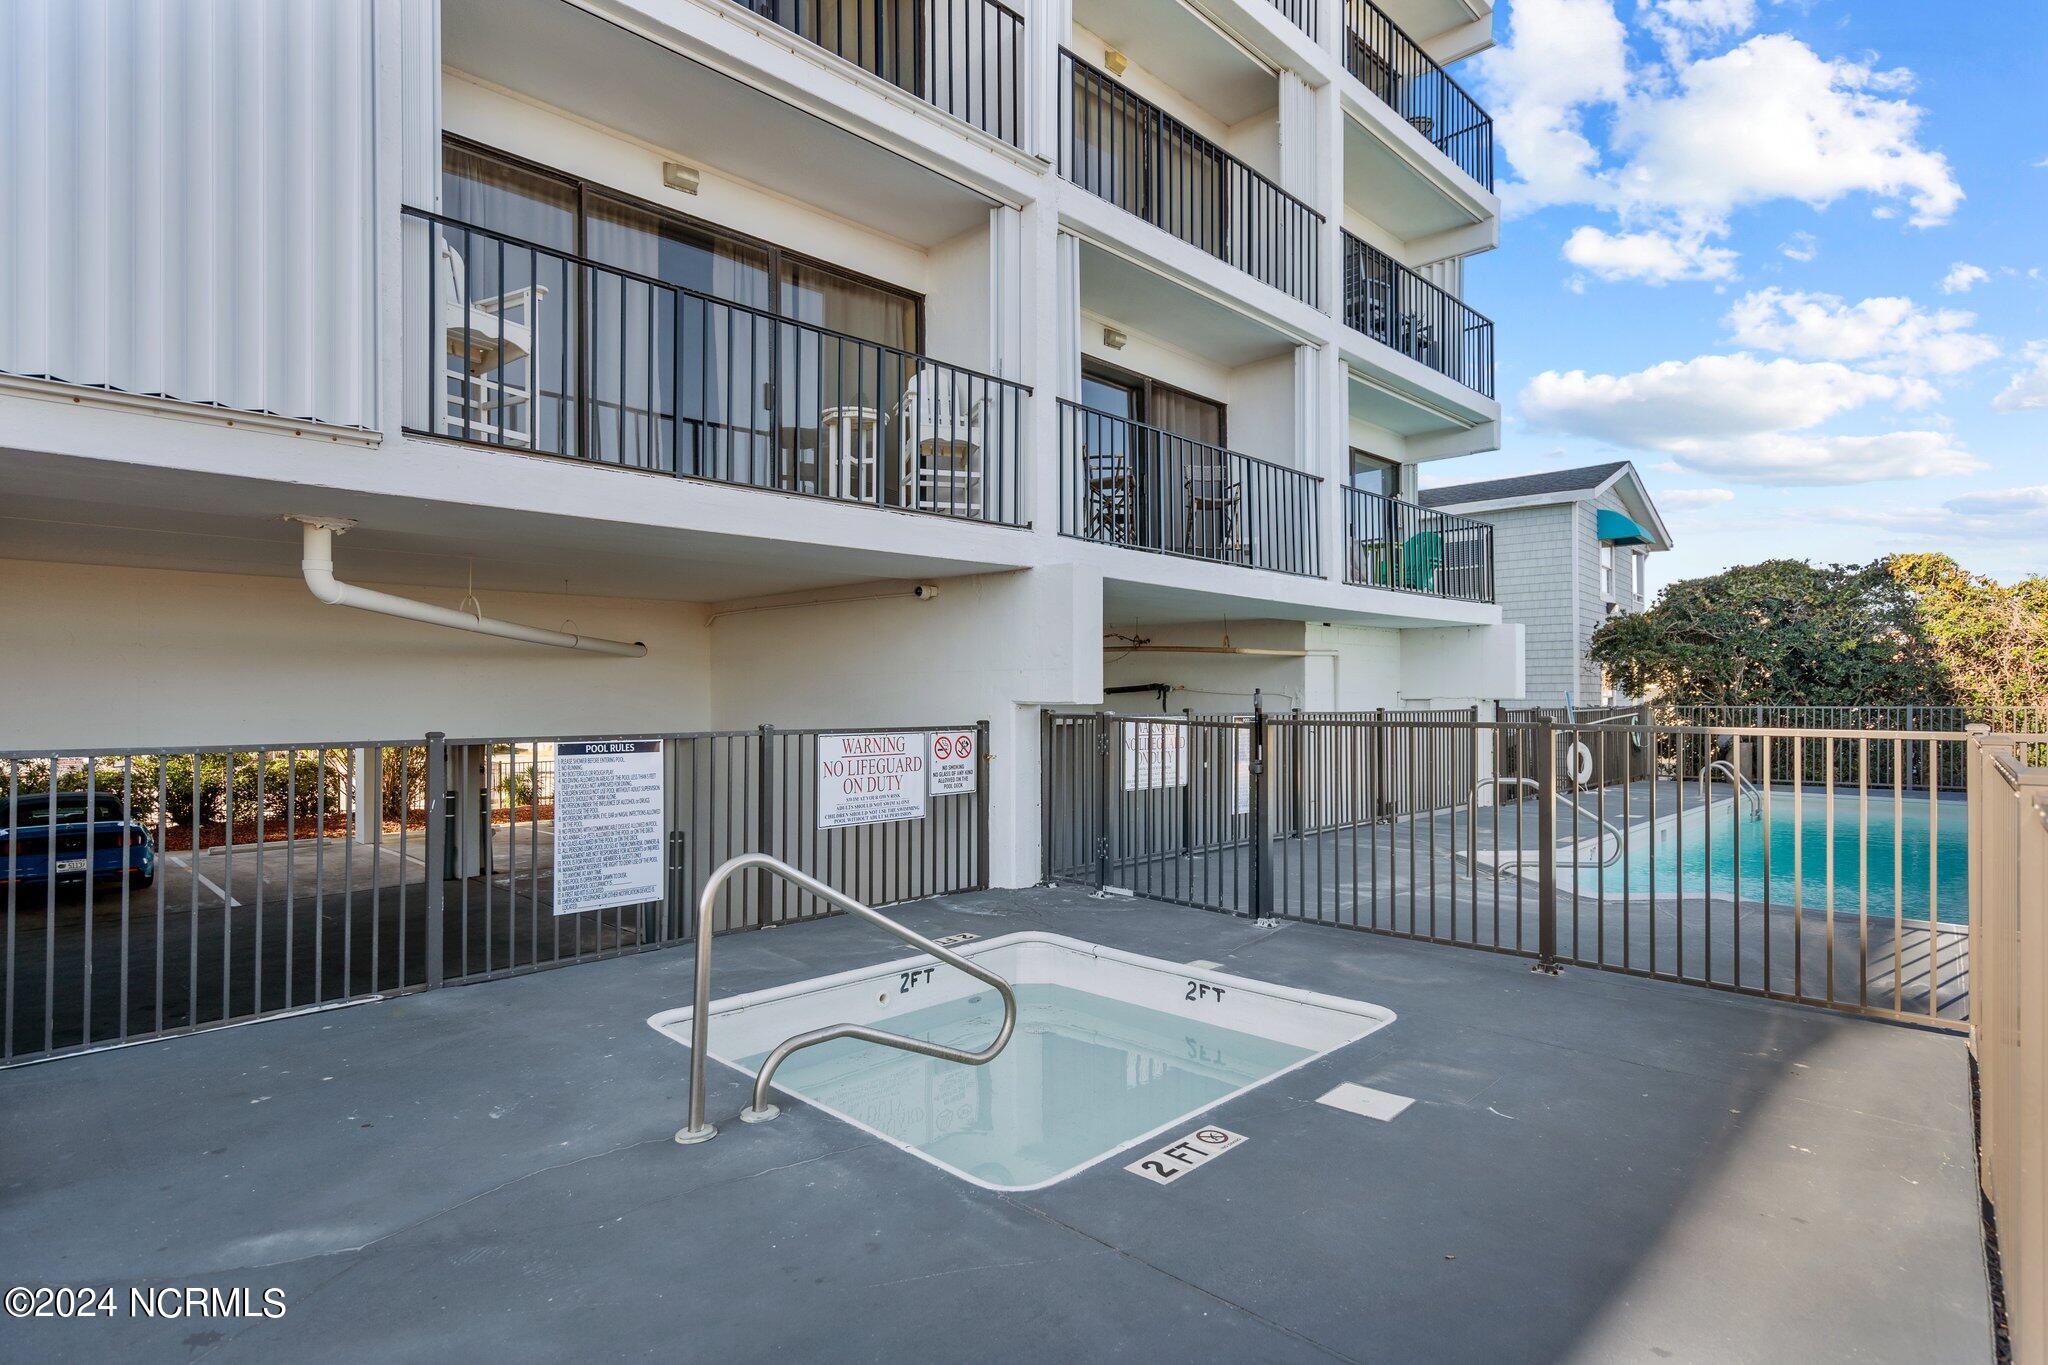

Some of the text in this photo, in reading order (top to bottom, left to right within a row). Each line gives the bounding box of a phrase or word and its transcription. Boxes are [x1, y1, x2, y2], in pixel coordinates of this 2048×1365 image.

[585, 743, 634, 752] POOL RULES
[842, 737, 905, 754] WARNING
[823, 757, 922, 778] NO LIFEGUARD
[843, 775, 903, 794] ON DUTY
[1141, 1160, 1179, 1178] 2
[1163, 1141, 1208, 1164] FT
